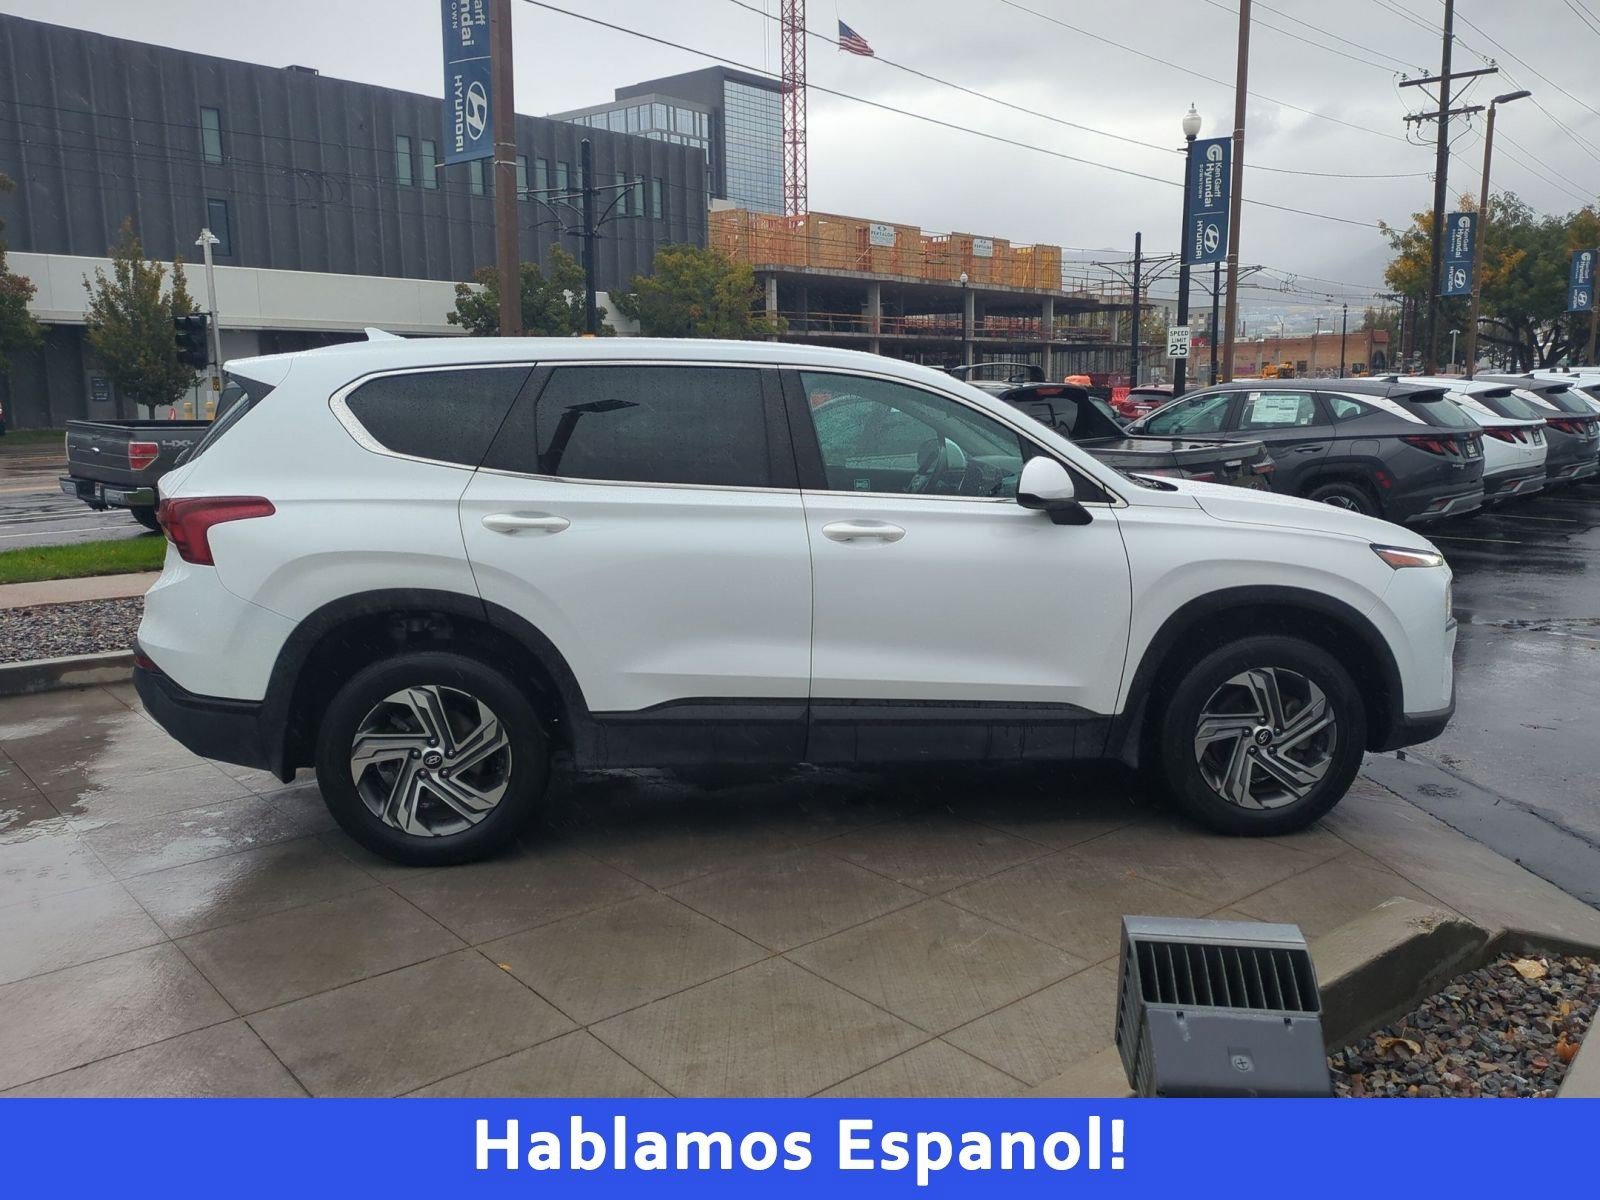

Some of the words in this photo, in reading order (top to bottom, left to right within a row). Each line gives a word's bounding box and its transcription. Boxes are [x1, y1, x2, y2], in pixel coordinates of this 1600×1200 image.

[454, 74, 464, 153] HYUNDAI
[1204, 163, 1214, 207] Hyundai
[1455, 229, 1463, 258] Hyundai
[1169, 344, 1188, 356] 25
